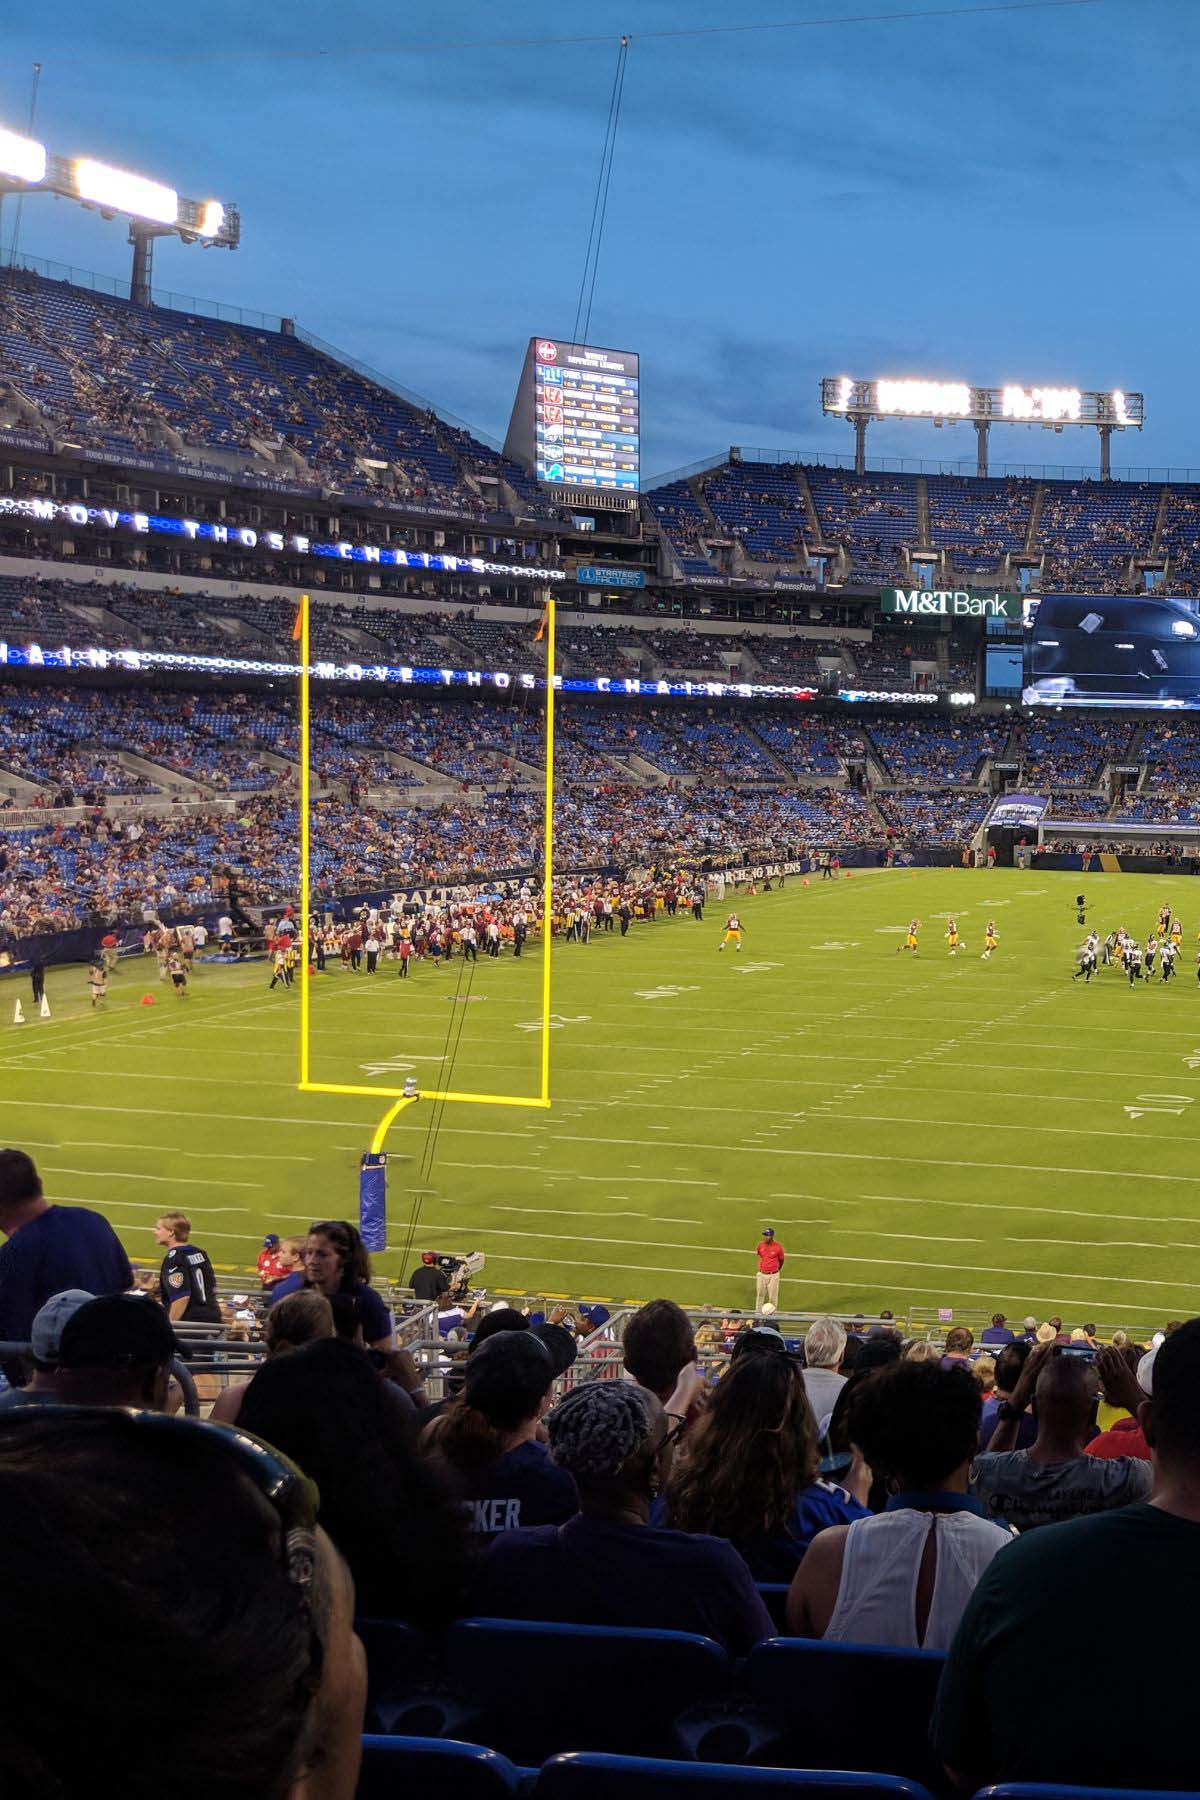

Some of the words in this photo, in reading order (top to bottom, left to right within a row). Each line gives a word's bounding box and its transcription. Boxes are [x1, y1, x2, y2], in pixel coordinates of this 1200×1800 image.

[34, 499, 149, 533] MOVE
[184, 521, 310, 553] THOSE
[339, 543, 485, 574] CHAINS
[596, 569, 641, 580] STRATEGIC
[596, 576, 641, 587] FACTORY
[894, 589, 953, 614] M&T
[954, 592, 1008, 617] Bank
[318, 662, 413, 684] MOVE
[442, 670, 563, 691] THOSE
[597, 677, 752, 698] CHAINS
[1122, 1093, 1197, 1116] 10
